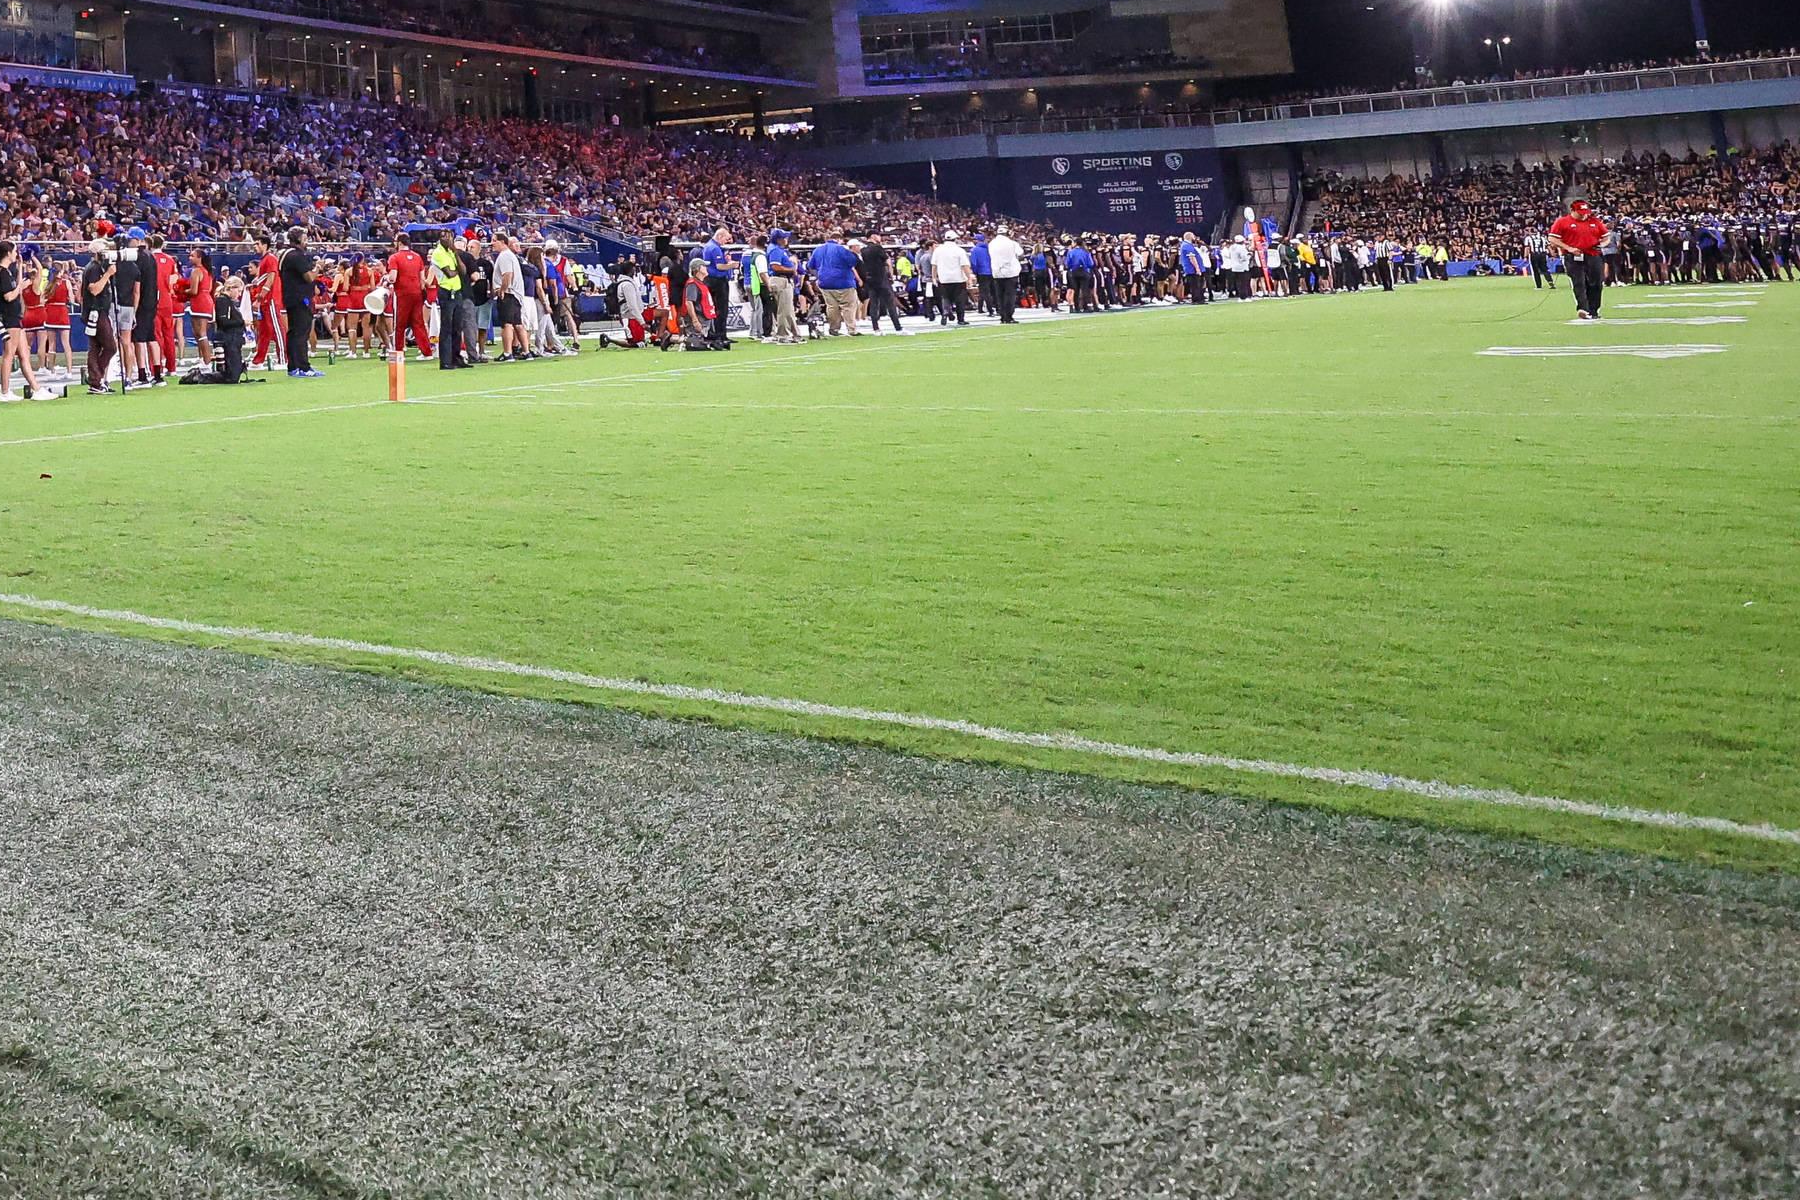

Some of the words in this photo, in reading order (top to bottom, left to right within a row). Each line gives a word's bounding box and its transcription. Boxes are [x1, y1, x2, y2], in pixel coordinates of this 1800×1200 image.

[1083, 156, 1152, 169] SPORTING
[1045, 200, 1073, 208] 2000
[1176, 216, 1204, 224] 2017
